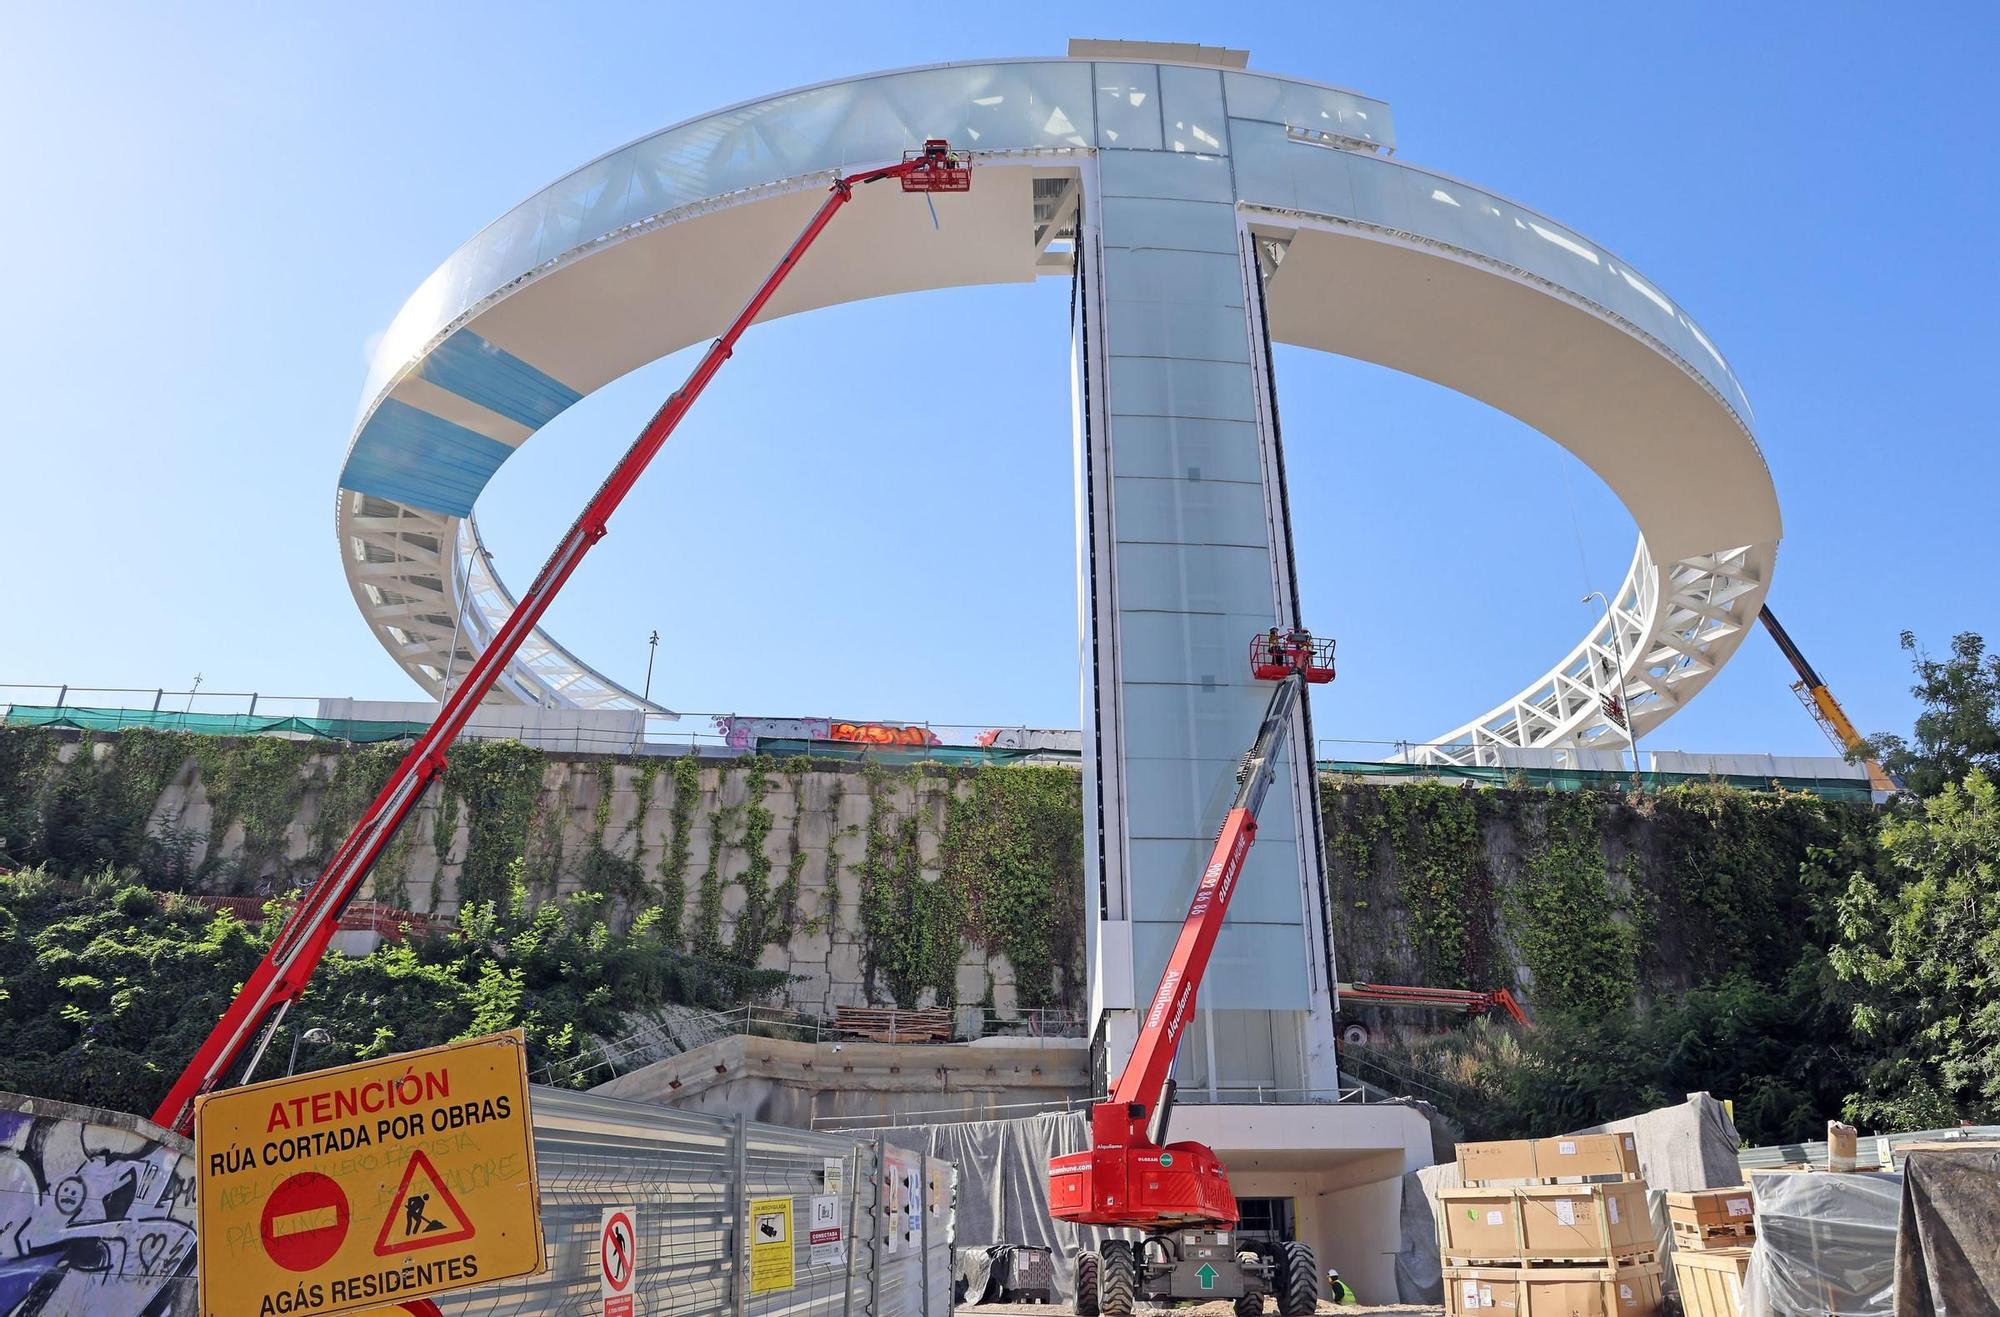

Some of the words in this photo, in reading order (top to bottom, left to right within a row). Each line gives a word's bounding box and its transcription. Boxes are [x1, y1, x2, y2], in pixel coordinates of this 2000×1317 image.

[1191, 904, 1207, 915] 86
[1148, 971, 1180, 1028] Alquilame
[1168, 981, 1192, 1044] Alquilame
[266, 1066, 449, 1133] ATENCIÓN
[210, 1143, 257, 1177] RÚA
[262, 1124, 371, 1166] CORTADA
[377, 1113, 425, 1143] POR
[431, 1095, 511, 1132] OBRAS
[259, 1281, 324, 1317] AGÁS
[331, 1255, 478, 1303] RESIDENTES
